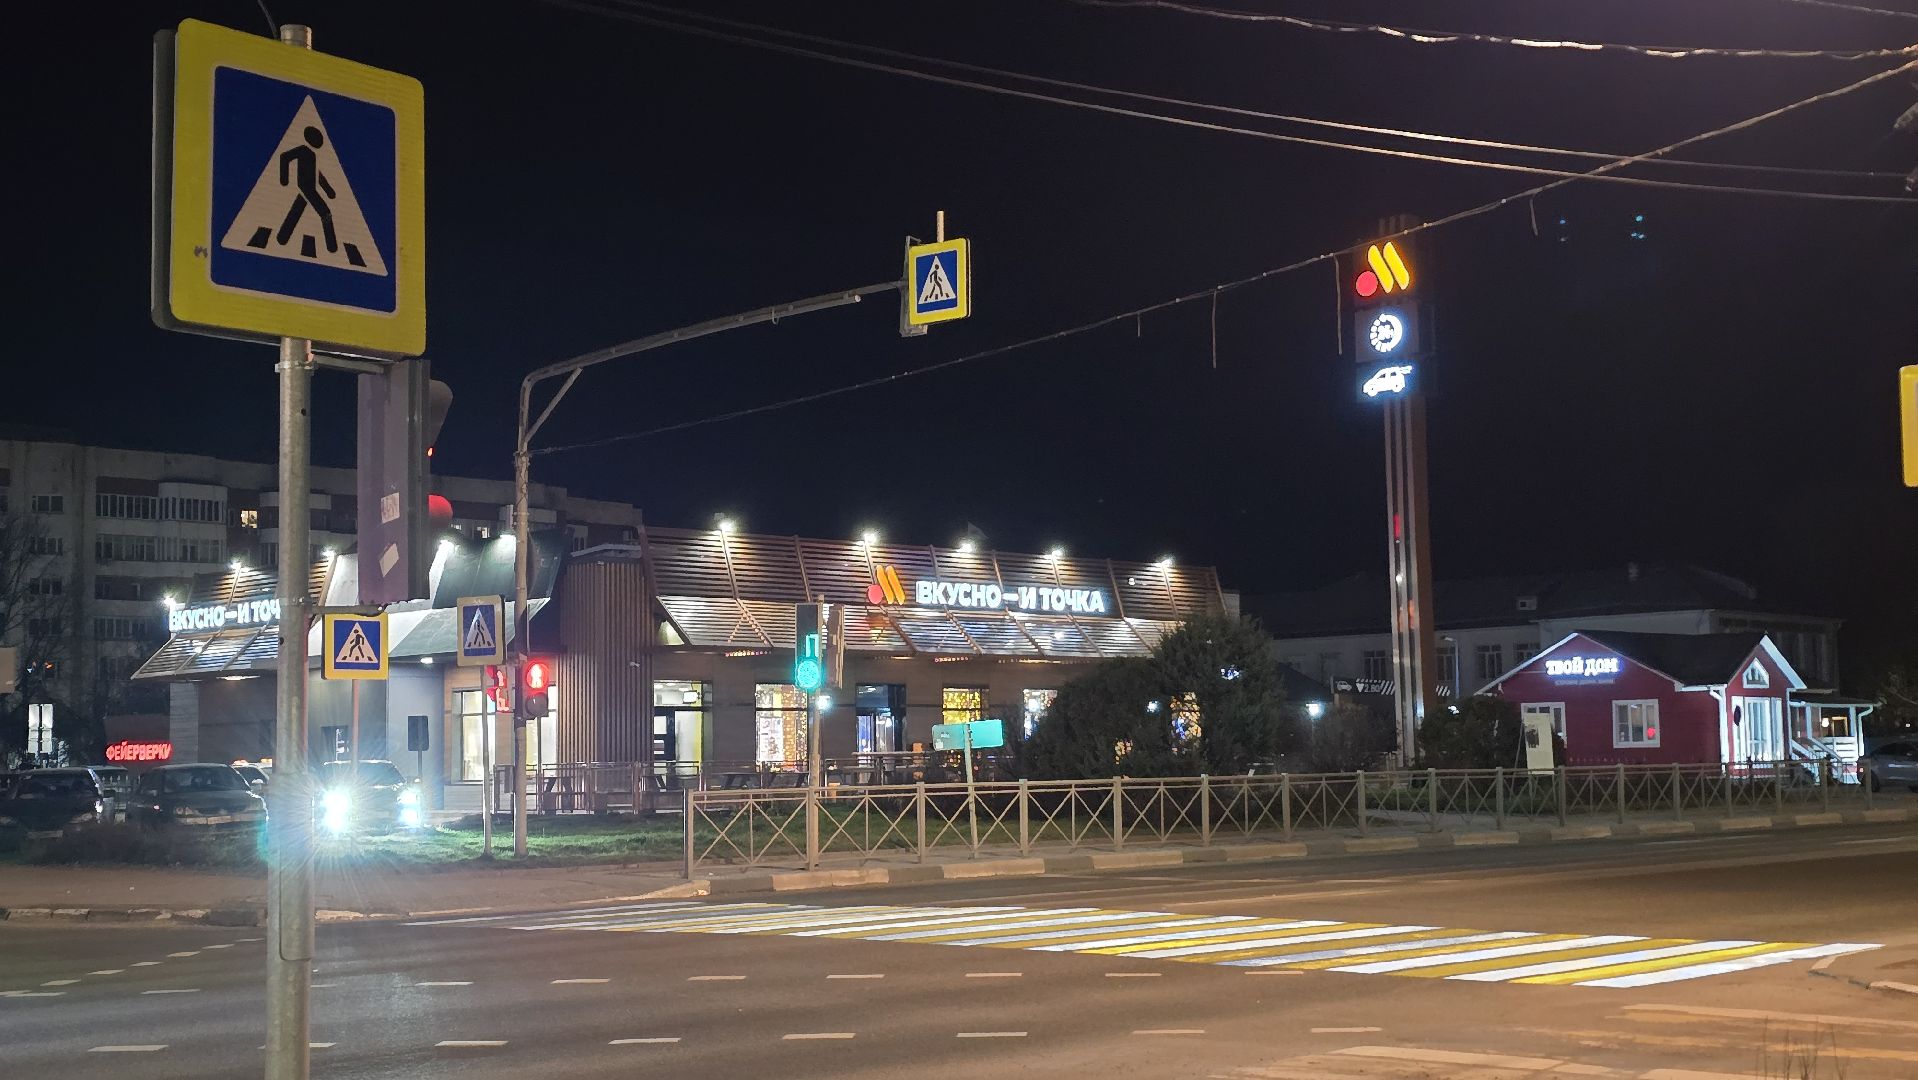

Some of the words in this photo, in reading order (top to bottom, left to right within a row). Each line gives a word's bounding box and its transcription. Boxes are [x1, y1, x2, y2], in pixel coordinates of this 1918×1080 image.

[1040, 588, 1105, 613] ТОЧКА
[1545, 656, 1584, 675] ТВОЙ
[1585, 657, 1619, 676] ДОМ
